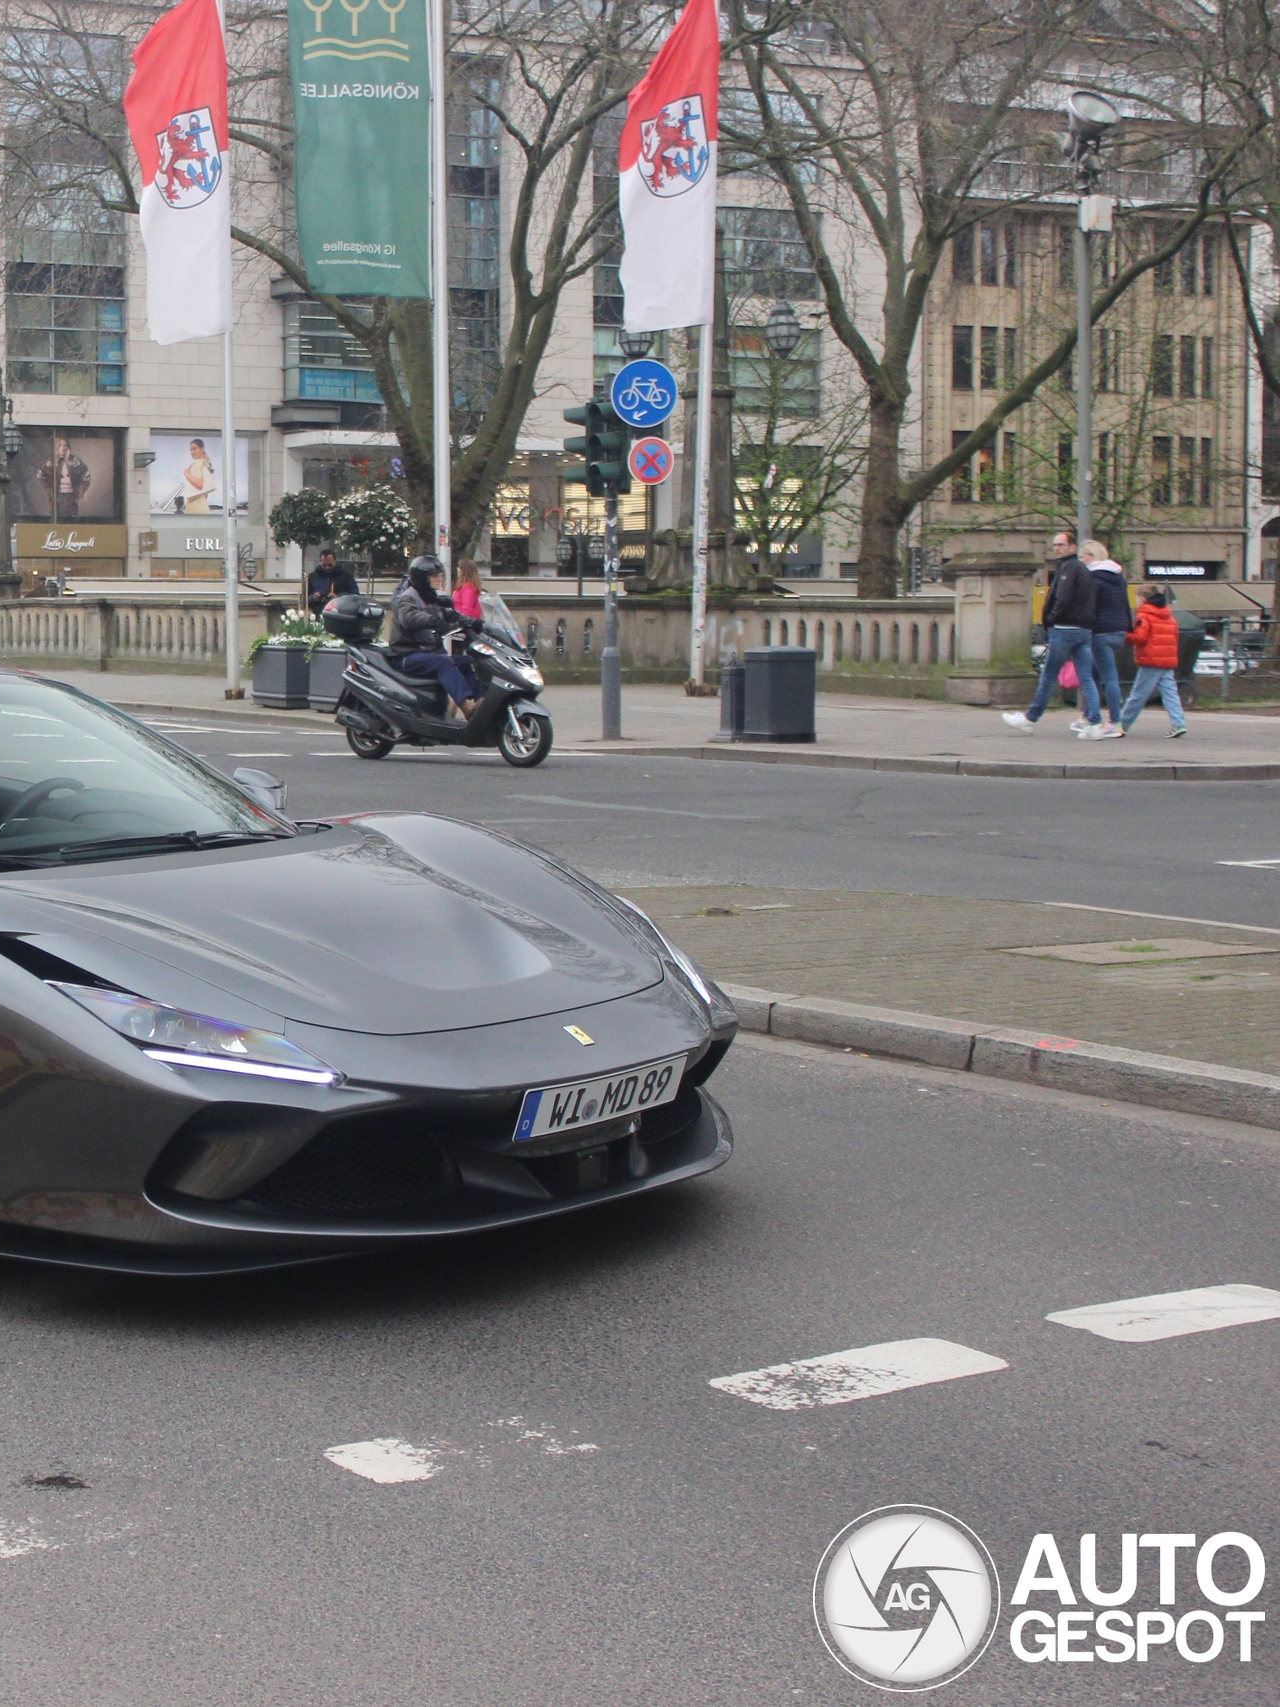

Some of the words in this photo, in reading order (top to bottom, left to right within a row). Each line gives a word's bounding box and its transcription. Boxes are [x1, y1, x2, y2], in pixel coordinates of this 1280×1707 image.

[186, 538, 224, 550] FURL
[548, 1088, 587, 1128] WI
[522, 1120, 529, 1130] D
